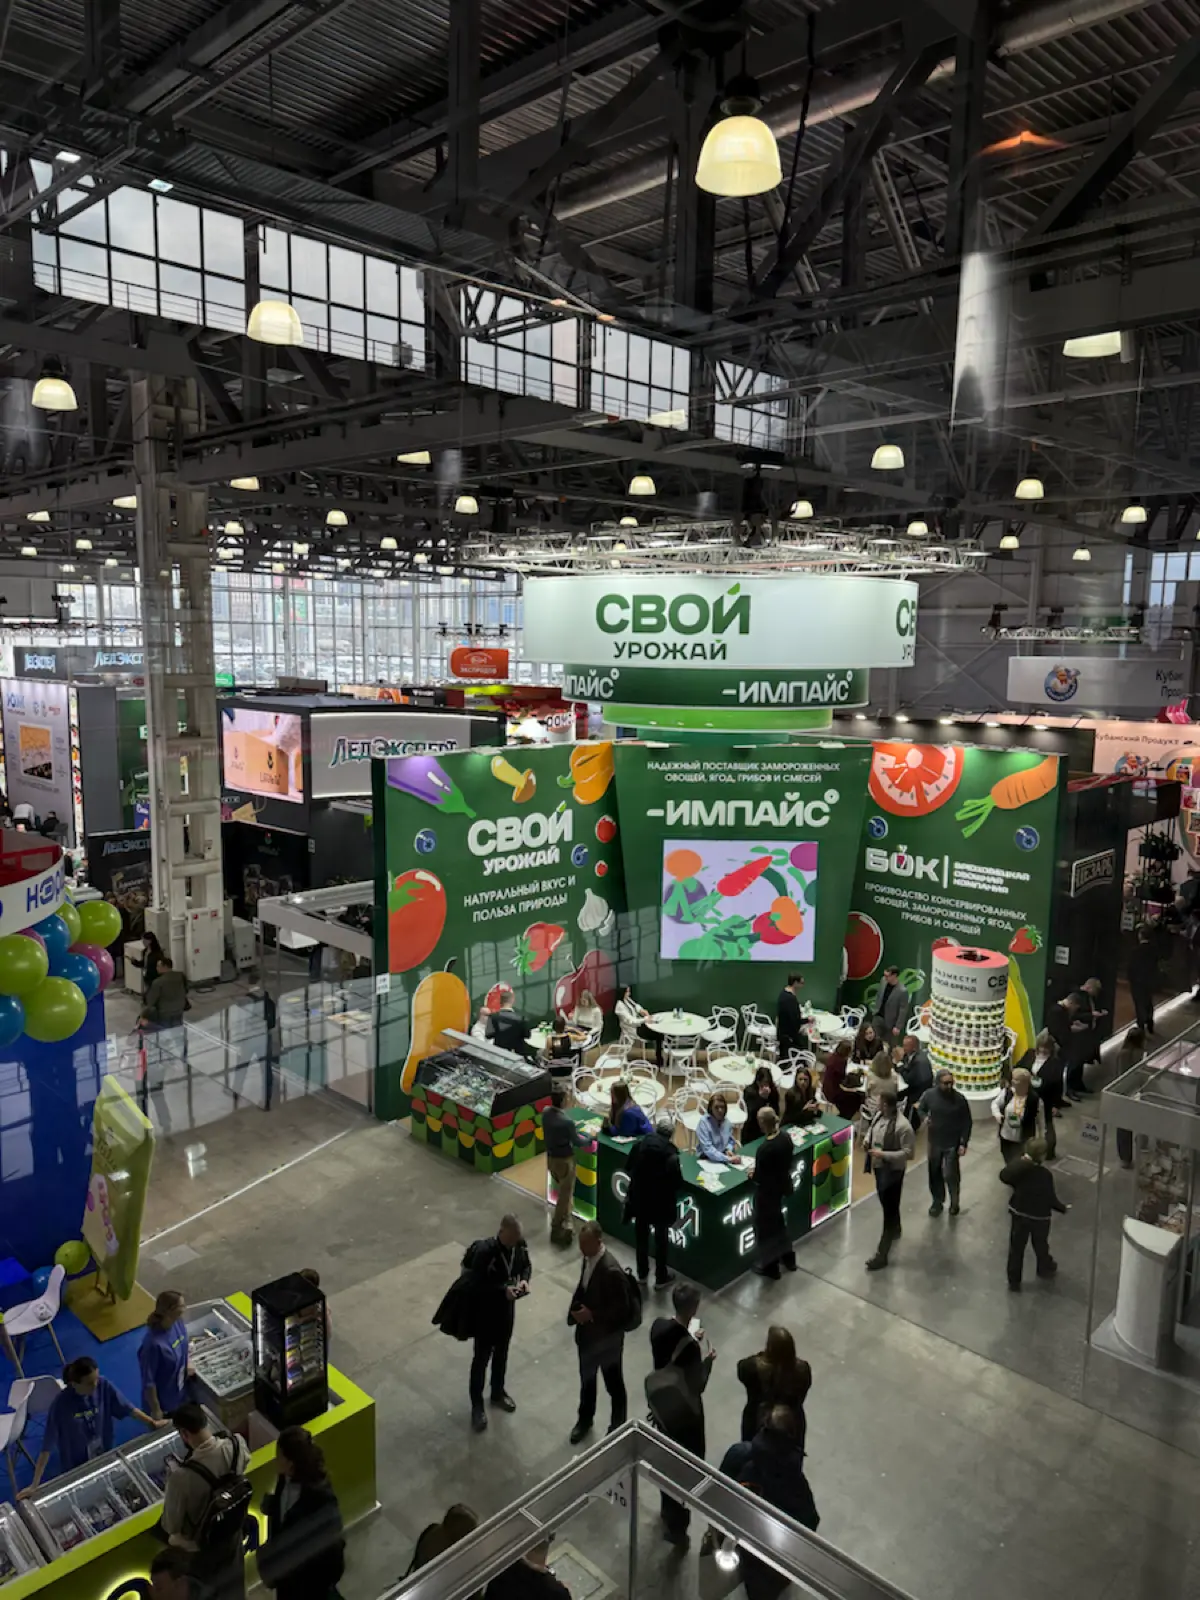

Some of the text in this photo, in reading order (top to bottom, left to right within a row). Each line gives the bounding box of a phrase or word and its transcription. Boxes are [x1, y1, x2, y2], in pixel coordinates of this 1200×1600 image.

[596, 583, 751, 635] СВОЙ
[613, 640, 728, 661] УРОЖАЙ
[647, 761, 840, 772] НАДЕЖНЫЙ ПОСТАВЩИК ЗАМОРОЖЕННЫХ
[709, 774, 736, 783] ЯГОД,
[737, 773, 773, 783] ГРИБОВ
[774, 774, 781, 783] И
[782, 772, 822, 783] СМЕСЕЙ
[467, 801, 573, 856] СВОЙ
[483, 846, 560, 876] УРОЖАЙ
[463, 875, 576, 907] НАТУРАЛЬНЫЙ ВКУС И
[864, 882, 1028, 920] ПРОИЗВОДСТВО КОНСЕРВИРОВАННЫХ
[472, 893, 568, 923] ПОЛЬЗА ПРИРОДЫ
[873, 895, 911, 910] ОВОЩЕЙ,
[911, 902, 986, 925] ЗАМОРОЖЕННЫХ
[901, 911, 981, 936] ГРИБОВ И ОВОЩЕЙ
[950, 982, 977, 993] БРЕНД
